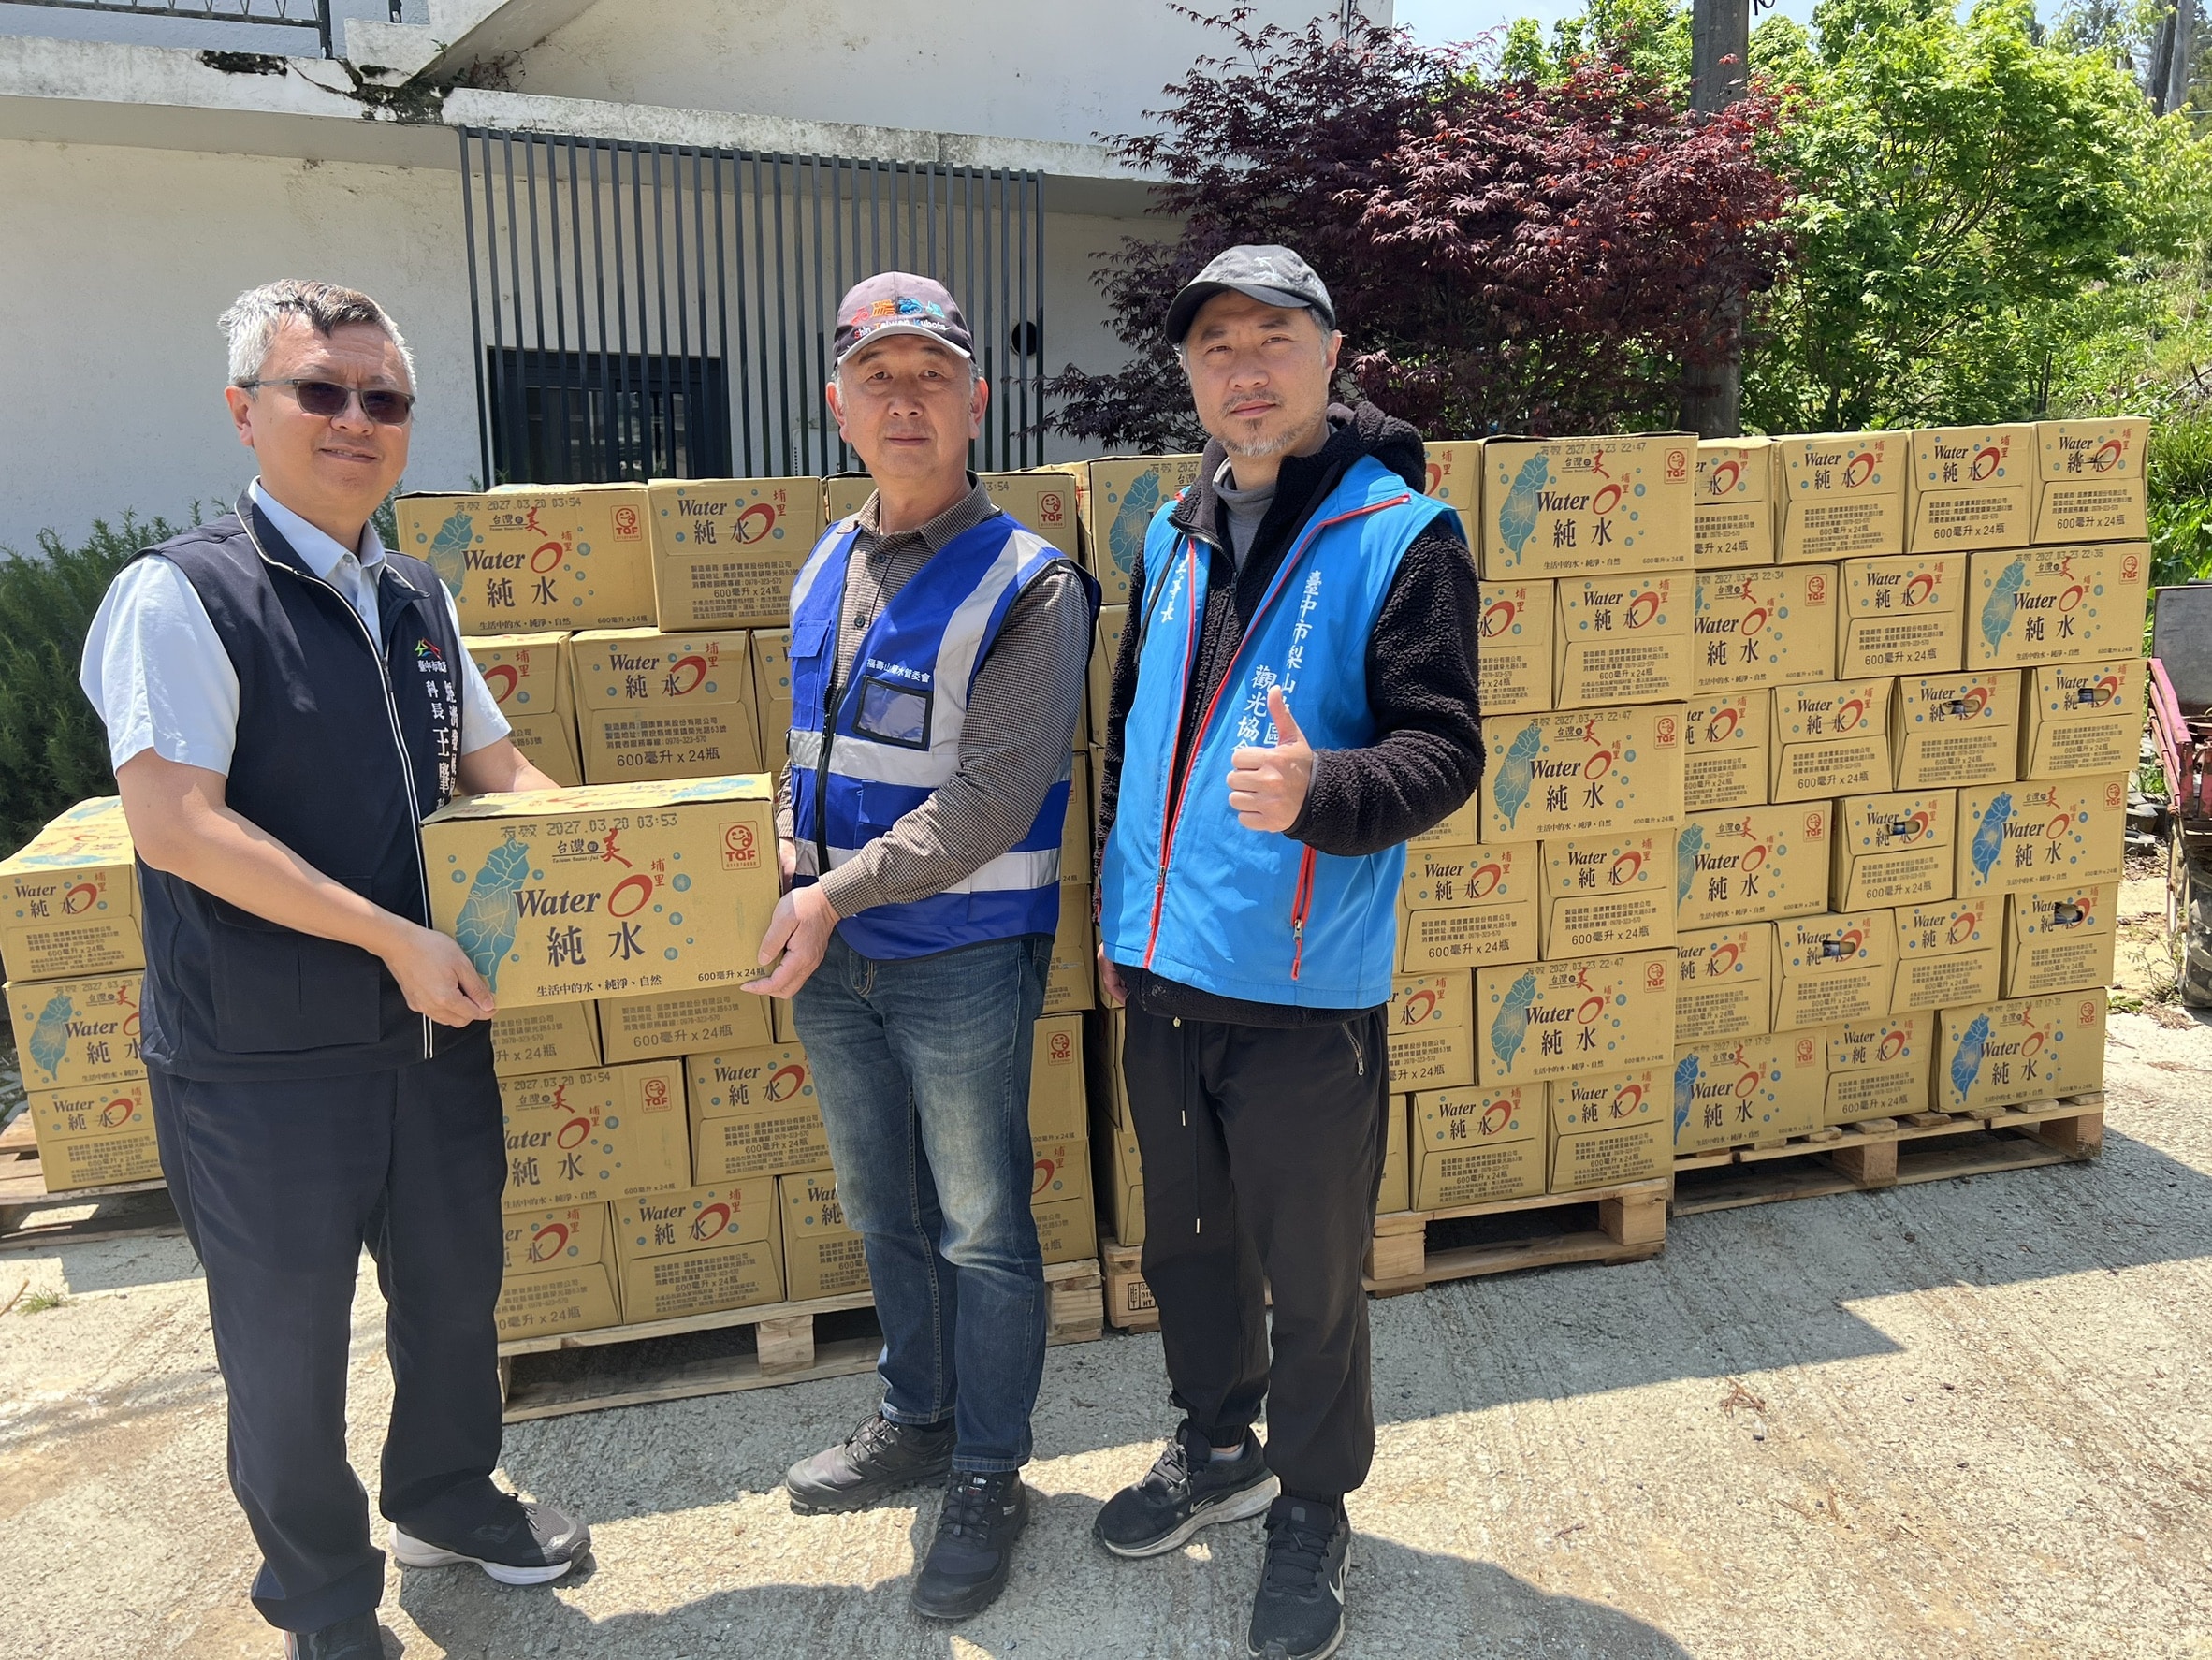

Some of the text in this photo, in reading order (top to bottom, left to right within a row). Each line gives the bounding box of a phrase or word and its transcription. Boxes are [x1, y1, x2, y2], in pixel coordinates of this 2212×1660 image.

[1621, 442, 1647, 452] 22:47
[1933, 444, 1970, 460] Water
[2059, 436, 2094, 451] Water
[1804, 452, 1842, 467] Water
[1814, 467, 1856, 491] 純水
[1942, 461, 1983, 484] 純水
[552, 497, 582, 508] 03:54
[677, 498, 728, 517] Water
[1536, 490, 1590, 513] Water
[693, 518, 751, 545] 純水
[1553, 517, 1613, 549] 純水
[1983, 522, 2006, 535] 24瓶
[462, 549, 526, 571] Water
[1866, 572, 1902, 587] Water
[487, 575, 560, 609] 純水
[1583, 590, 1623, 607] Water
[1874, 587, 1916, 610] 純水
[2013, 592, 2058, 610] Water
[1594, 605, 1639, 632] 純水
[1694, 616, 1739, 635] Water
[2025, 614, 2075, 643] 純水
[1706, 637, 1760, 667] 純水
[1864, 651, 1905, 666] 600毫升
[1914, 648, 1938, 663] 24瓶
[609, 653, 660, 672] Water
[625, 673, 682, 700] 純水
[2056, 676, 2089, 690] Water
[1920, 687, 1956, 702] Water
[1797, 699, 1833, 713] Water
[1806, 713, 1847, 735] 純水
[616, 750, 673, 767] 600毫升
[689, 746, 720, 763] 24瓶
[1529, 759, 1582, 780] Water
[1545, 781, 1605, 813] 純水
[636, 812, 678, 830] 03:53
[1866, 811, 1900, 826] Water
[2002, 822, 2045, 839] Water
[1567, 851, 1608, 866] Water
[1694, 853, 1740, 872] Water
[2014, 840, 2063, 869] 純水
[650, 858, 666, 887] 埔里
[1424, 863, 1465, 878] Water
[1578, 866, 1624, 889] 純水
[14, 885, 57, 898] Water
[1434, 878, 1481, 902] 純水
[1708, 873, 1760, 902] 純水
[514, 888, 602, 918] Water
[1914, 914, 1946, 929] Water
[546, 921, 646, 968] 純水
[1571, 929, 1615, 946] 600毫升
[1626, 925, 1651, 939] 24瓶
[1797, 932, 1832, 946] Water
[1921, 927, 1959, 950] 純水
[1428, 943, 1473, 959] 600毫升
[1484, 939, 1510, 953] 24瓶
[744, 967, 766, 979] 24瓶
[1524, 1006, 1576, 1026] Water
[65, 1020, 119, 1040] Water
[633, 1028, 689, 1049] 600毫升
[702, 1024, 734, 1041] 24瓶
[1843, 1030, 1876, 1045] Water
[1540, 1027, 1597, 1057] 純水
[1980, 1041, 2021, 1058] Water
[1851, 1043, 1889, 1065] 純水
[713, 1066, 762, 1084] Water
[1991, 1058, 2039, 1086] 純水
[729, 1079, 781, 1108] 純水
[1570, 1086, 1608, 1103] Water
[1690, 1082, 1734, 1100] Water
[53, 1099, 95, 1114] Water
[1438, 1102, 1477, 1119] Water
[1581, 1099, 1623, 1124] 純水
[1703, 1099, 1754, 1129] 純水
[1449, 1115, 1492, 1141] 純水
[505, 1129, 552, 1151] ater
[511, 1151, 585, 1187] 純水
[639, 1203, 687, 1223] Water
[654, 1218, 707, 1246] 純水
